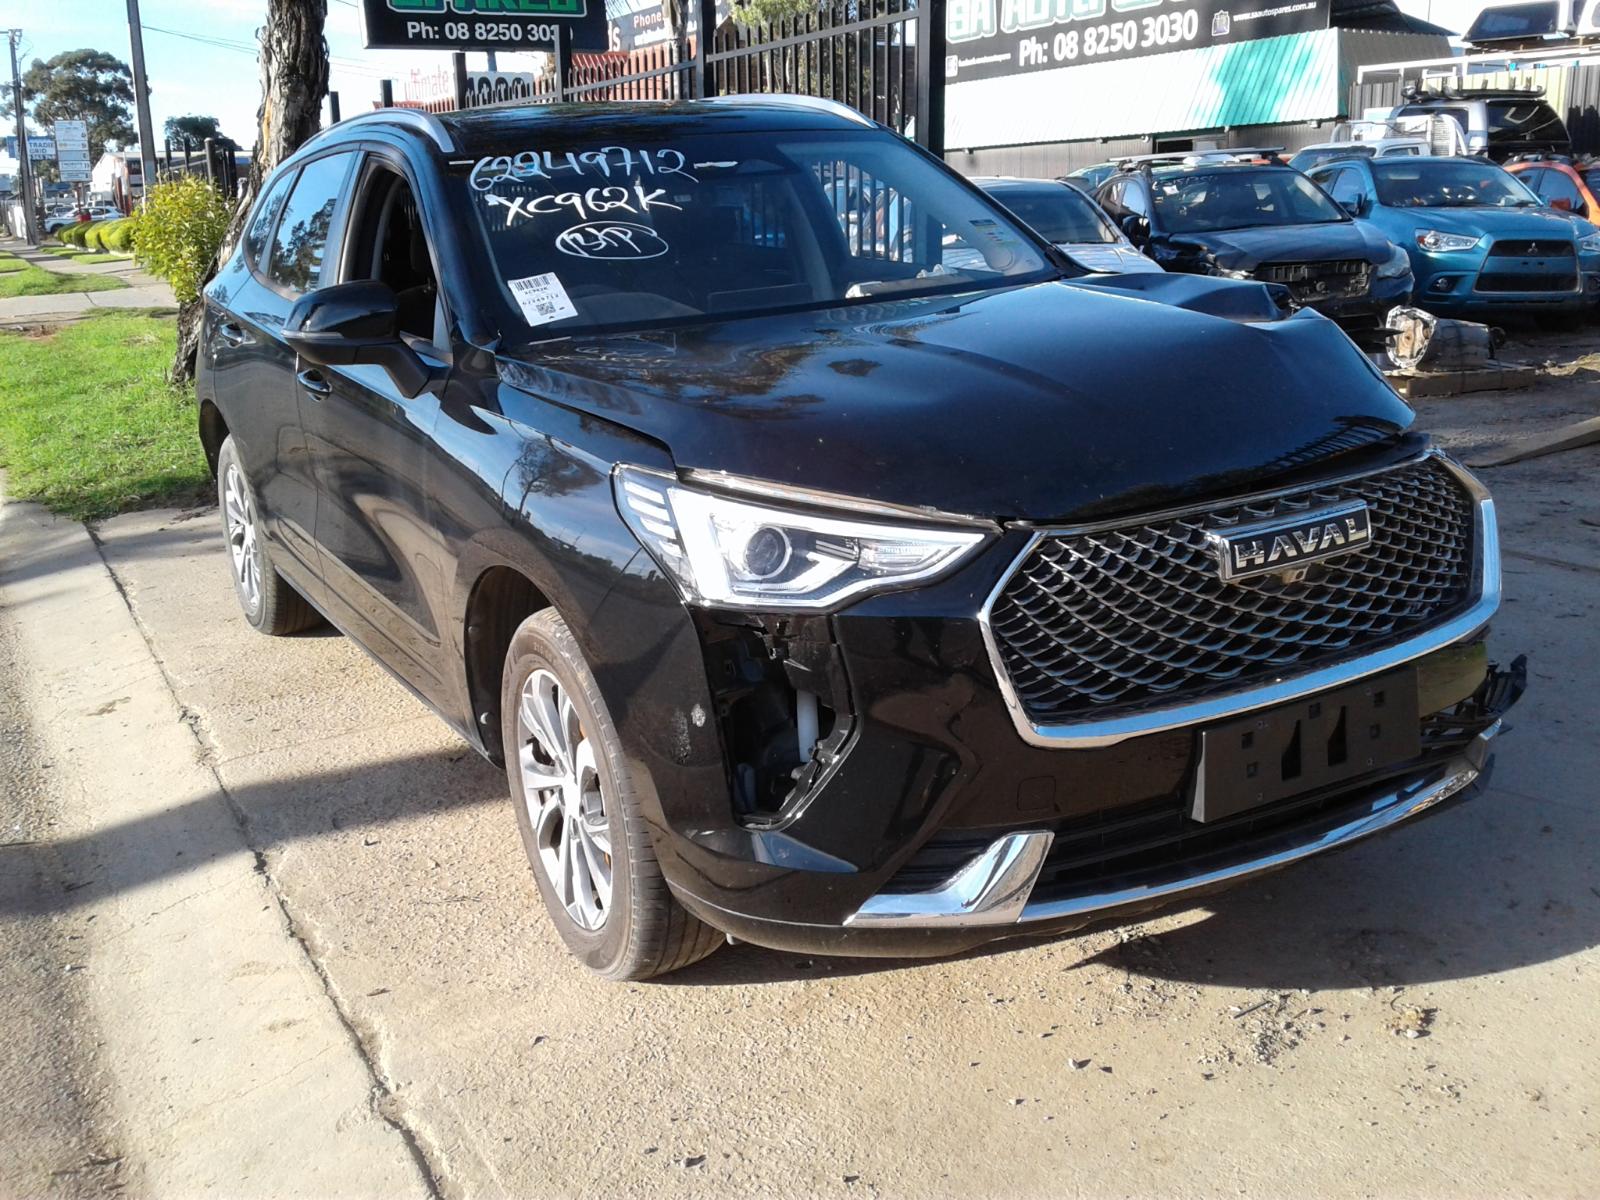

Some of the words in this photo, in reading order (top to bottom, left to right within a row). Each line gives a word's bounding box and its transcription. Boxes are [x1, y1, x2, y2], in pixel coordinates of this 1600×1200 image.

[406, 21, 440, 39] Ph:
[444, 22, 469, 40] 08
[474, 23, 522, 41] 8250
[527, 24, 574, 42] 303
[633, 11, 662, 28] Phone
[1018, 36, 1049, 66] Ph:
[1053, 30, 1079, 62] 08
[1083, 20, 1138, 57] 8250
[1140, 9, 1199, 48] 3030
[484, 174, 683, 227] XC962K
[1234, 518, 1368, 569] HAVAL
